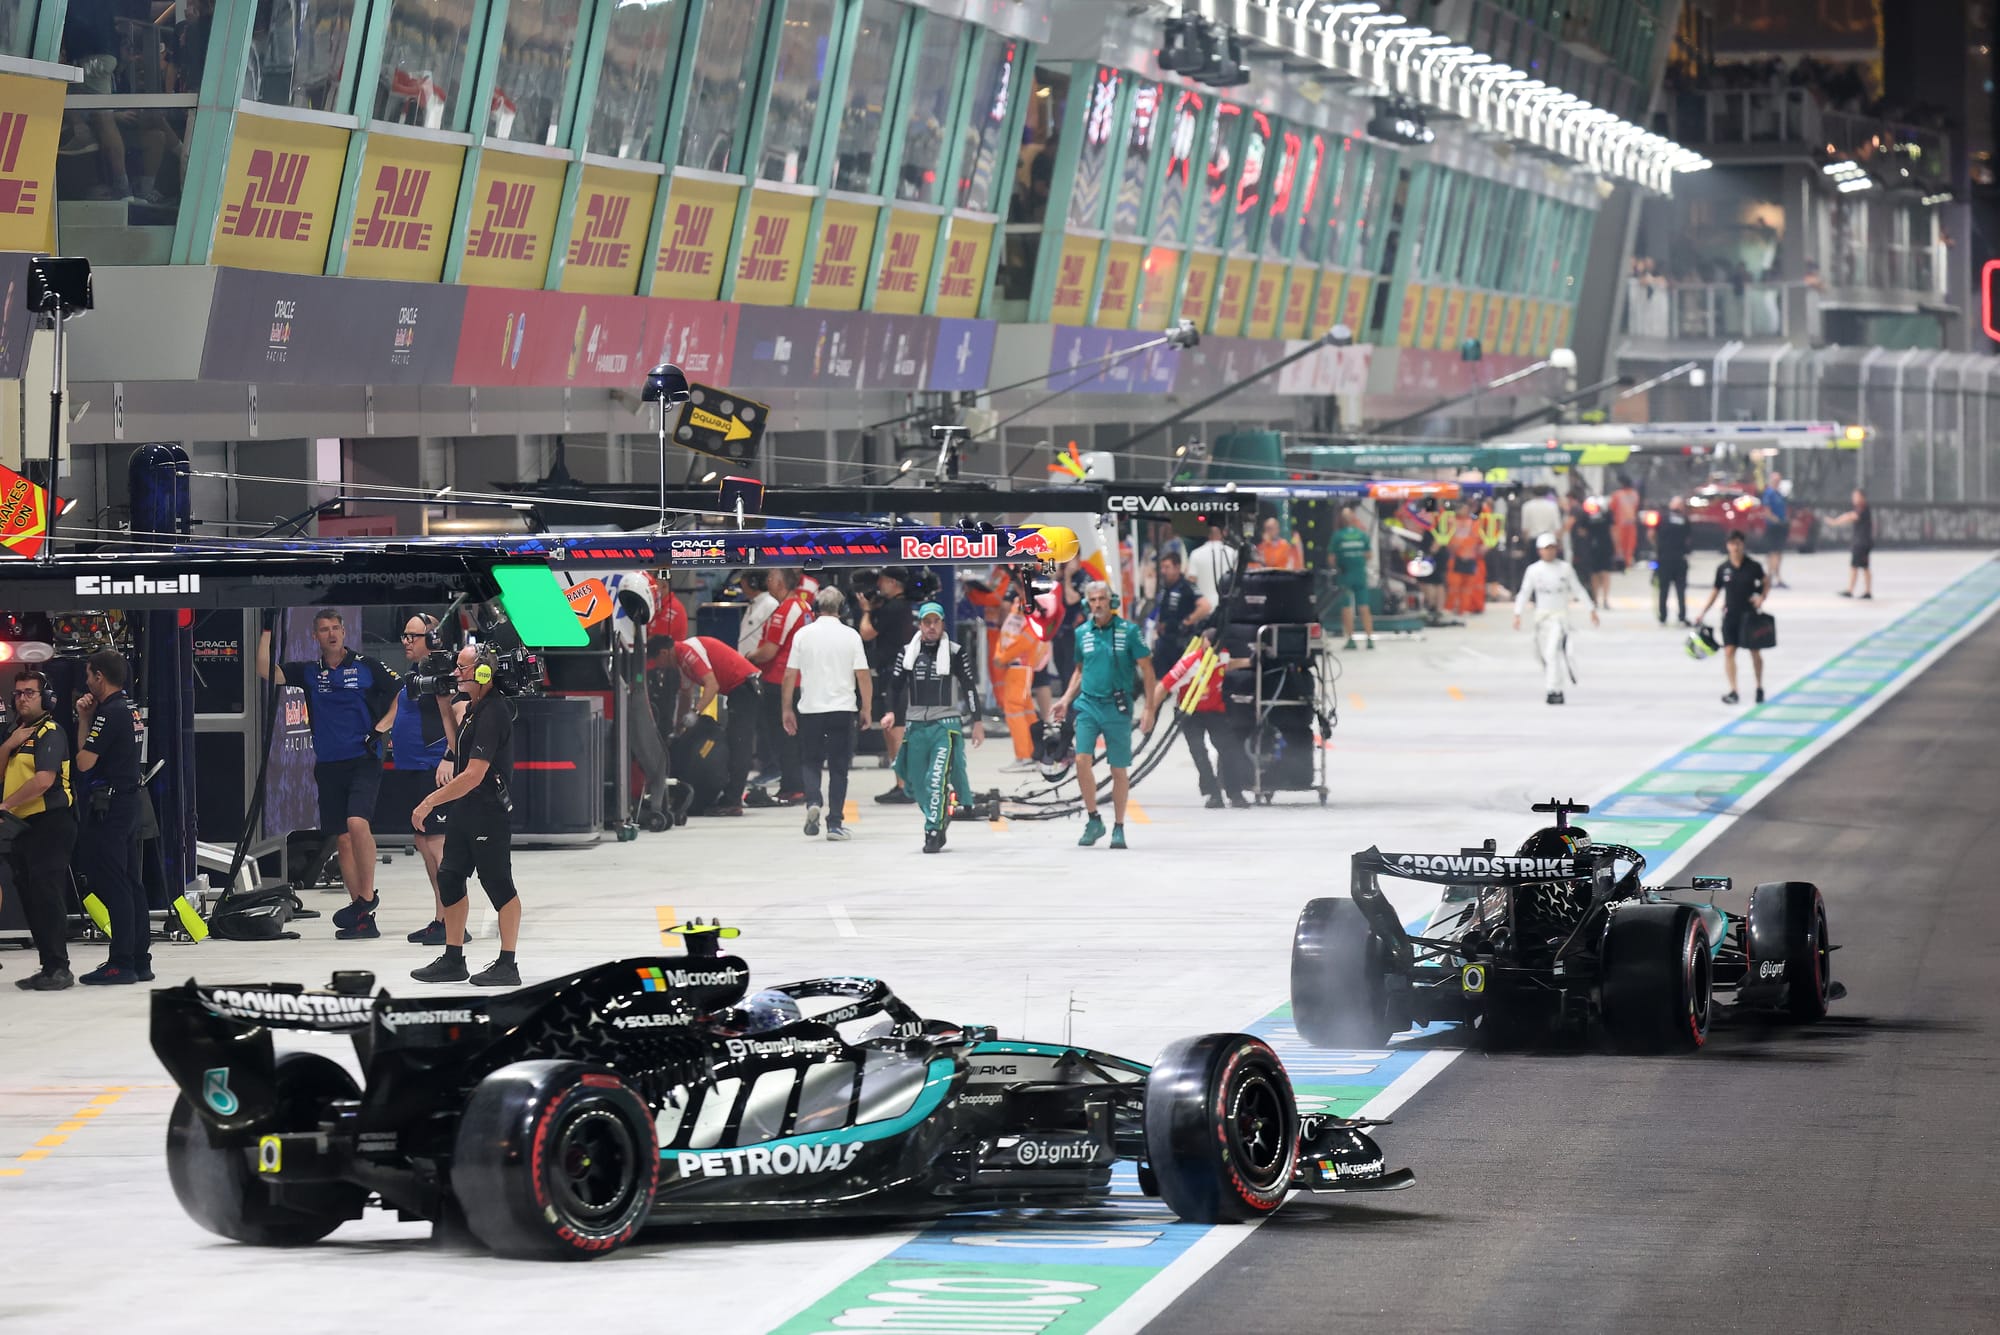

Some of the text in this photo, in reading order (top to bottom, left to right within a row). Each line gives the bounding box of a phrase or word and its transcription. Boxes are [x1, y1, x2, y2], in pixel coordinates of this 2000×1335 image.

[1173, 502, 1240, 512] LOGISTICS
[14, 505, 33, 527] ON
[671, 539, 725, 548] ORACLE
[901, 535, 998, 559] Red Bull
[75, 575, 200, 596] Einhell
[566, 584, 593, 602] RAKES
[195, 640, 238, 648] ORACLE
[928, 746, 948, 824] ASTON MARTIN
[1397, 854, 1576, 877] CROWDSTRIKE
[665, 966, 740, 988] Microsoft
[388, 1010, 472, 1026] CROWDSTRIKE
[625, 1014, 682, 1029] SOLERA
[827, 1008, 851, 1025] AMD
[743, 1036, 828, 1055] TeamViewer
[979, 1065, 1017, 1075] AMG
[959, 1092, 1003, 1107] Snapdragon
[677, 1141, 862, 1178] PETRONAS
[1335, 1160, 1384, 1176] Microsoft
